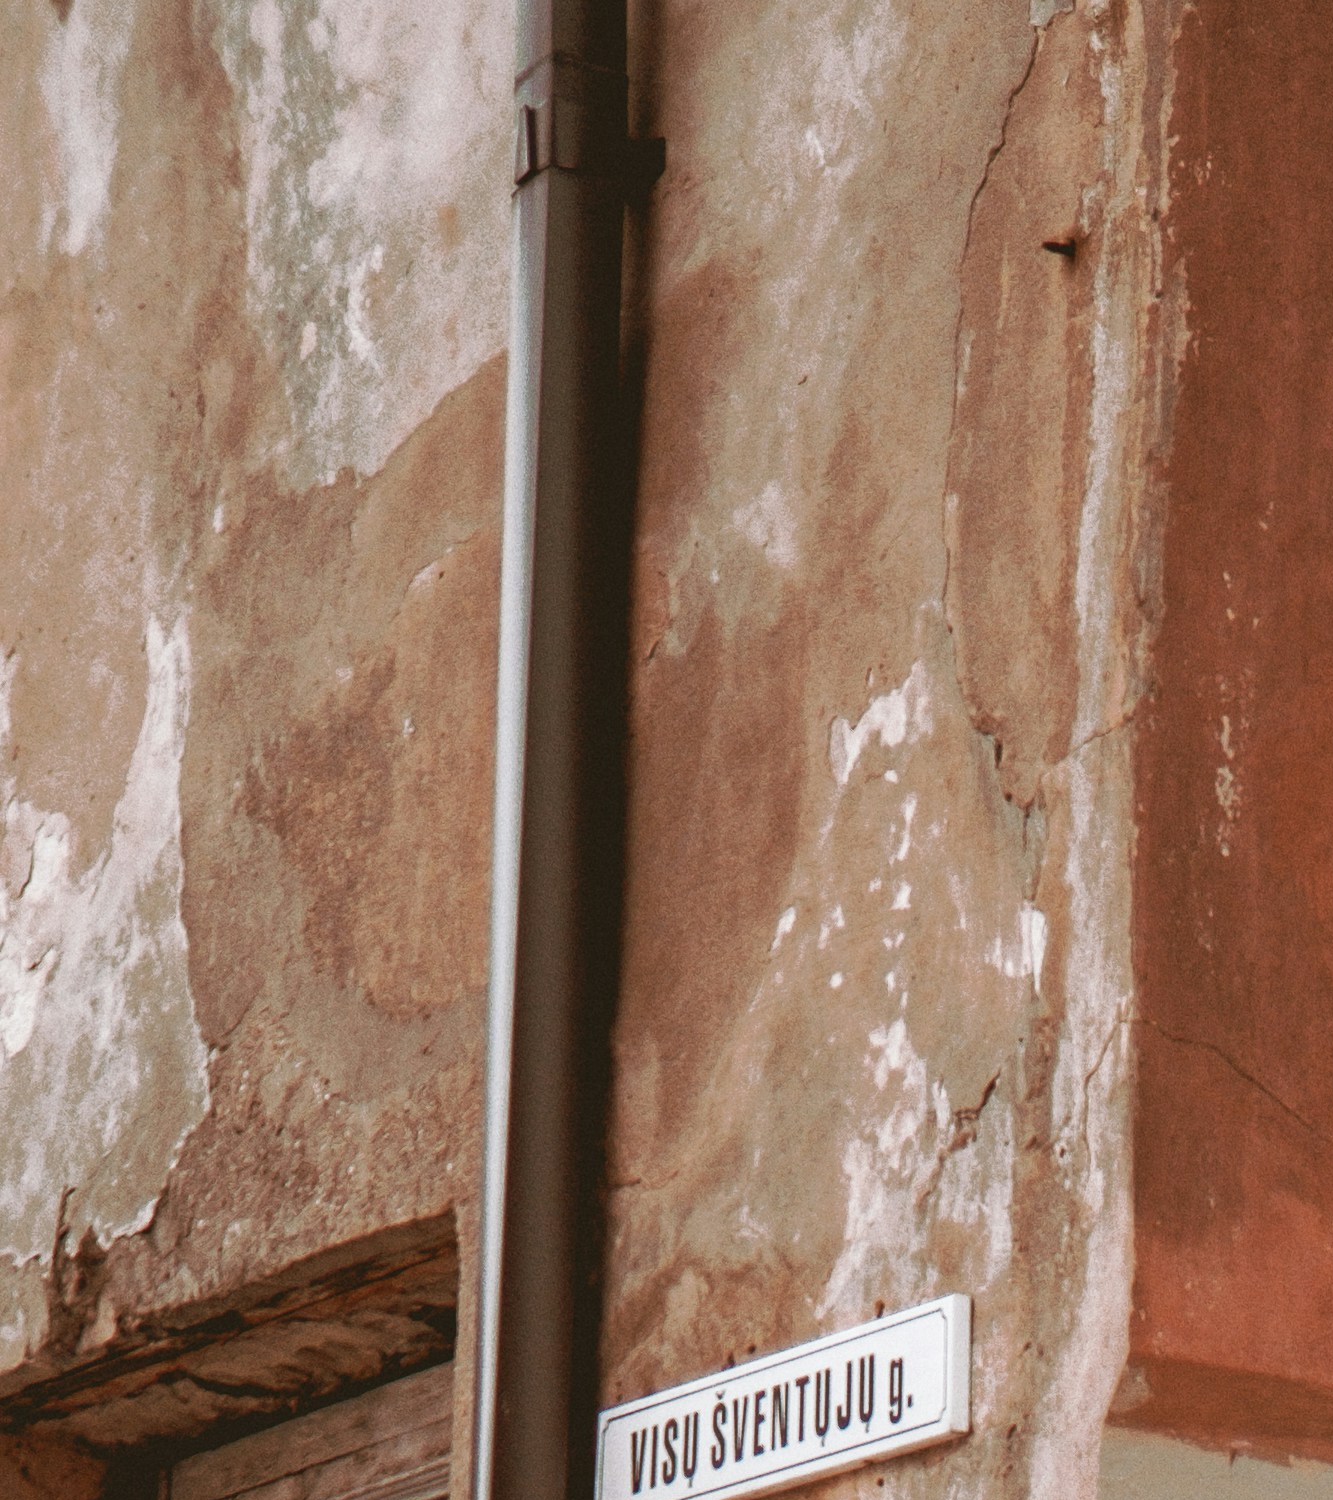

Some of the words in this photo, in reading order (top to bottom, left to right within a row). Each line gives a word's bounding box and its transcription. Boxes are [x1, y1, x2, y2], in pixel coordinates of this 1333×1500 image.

[631, 1412, 699, 1495] VISŲ
[710, 1354, 876, 1470] ŠVENTŲJŲ
[889, 1357, 914, 1424] g.
